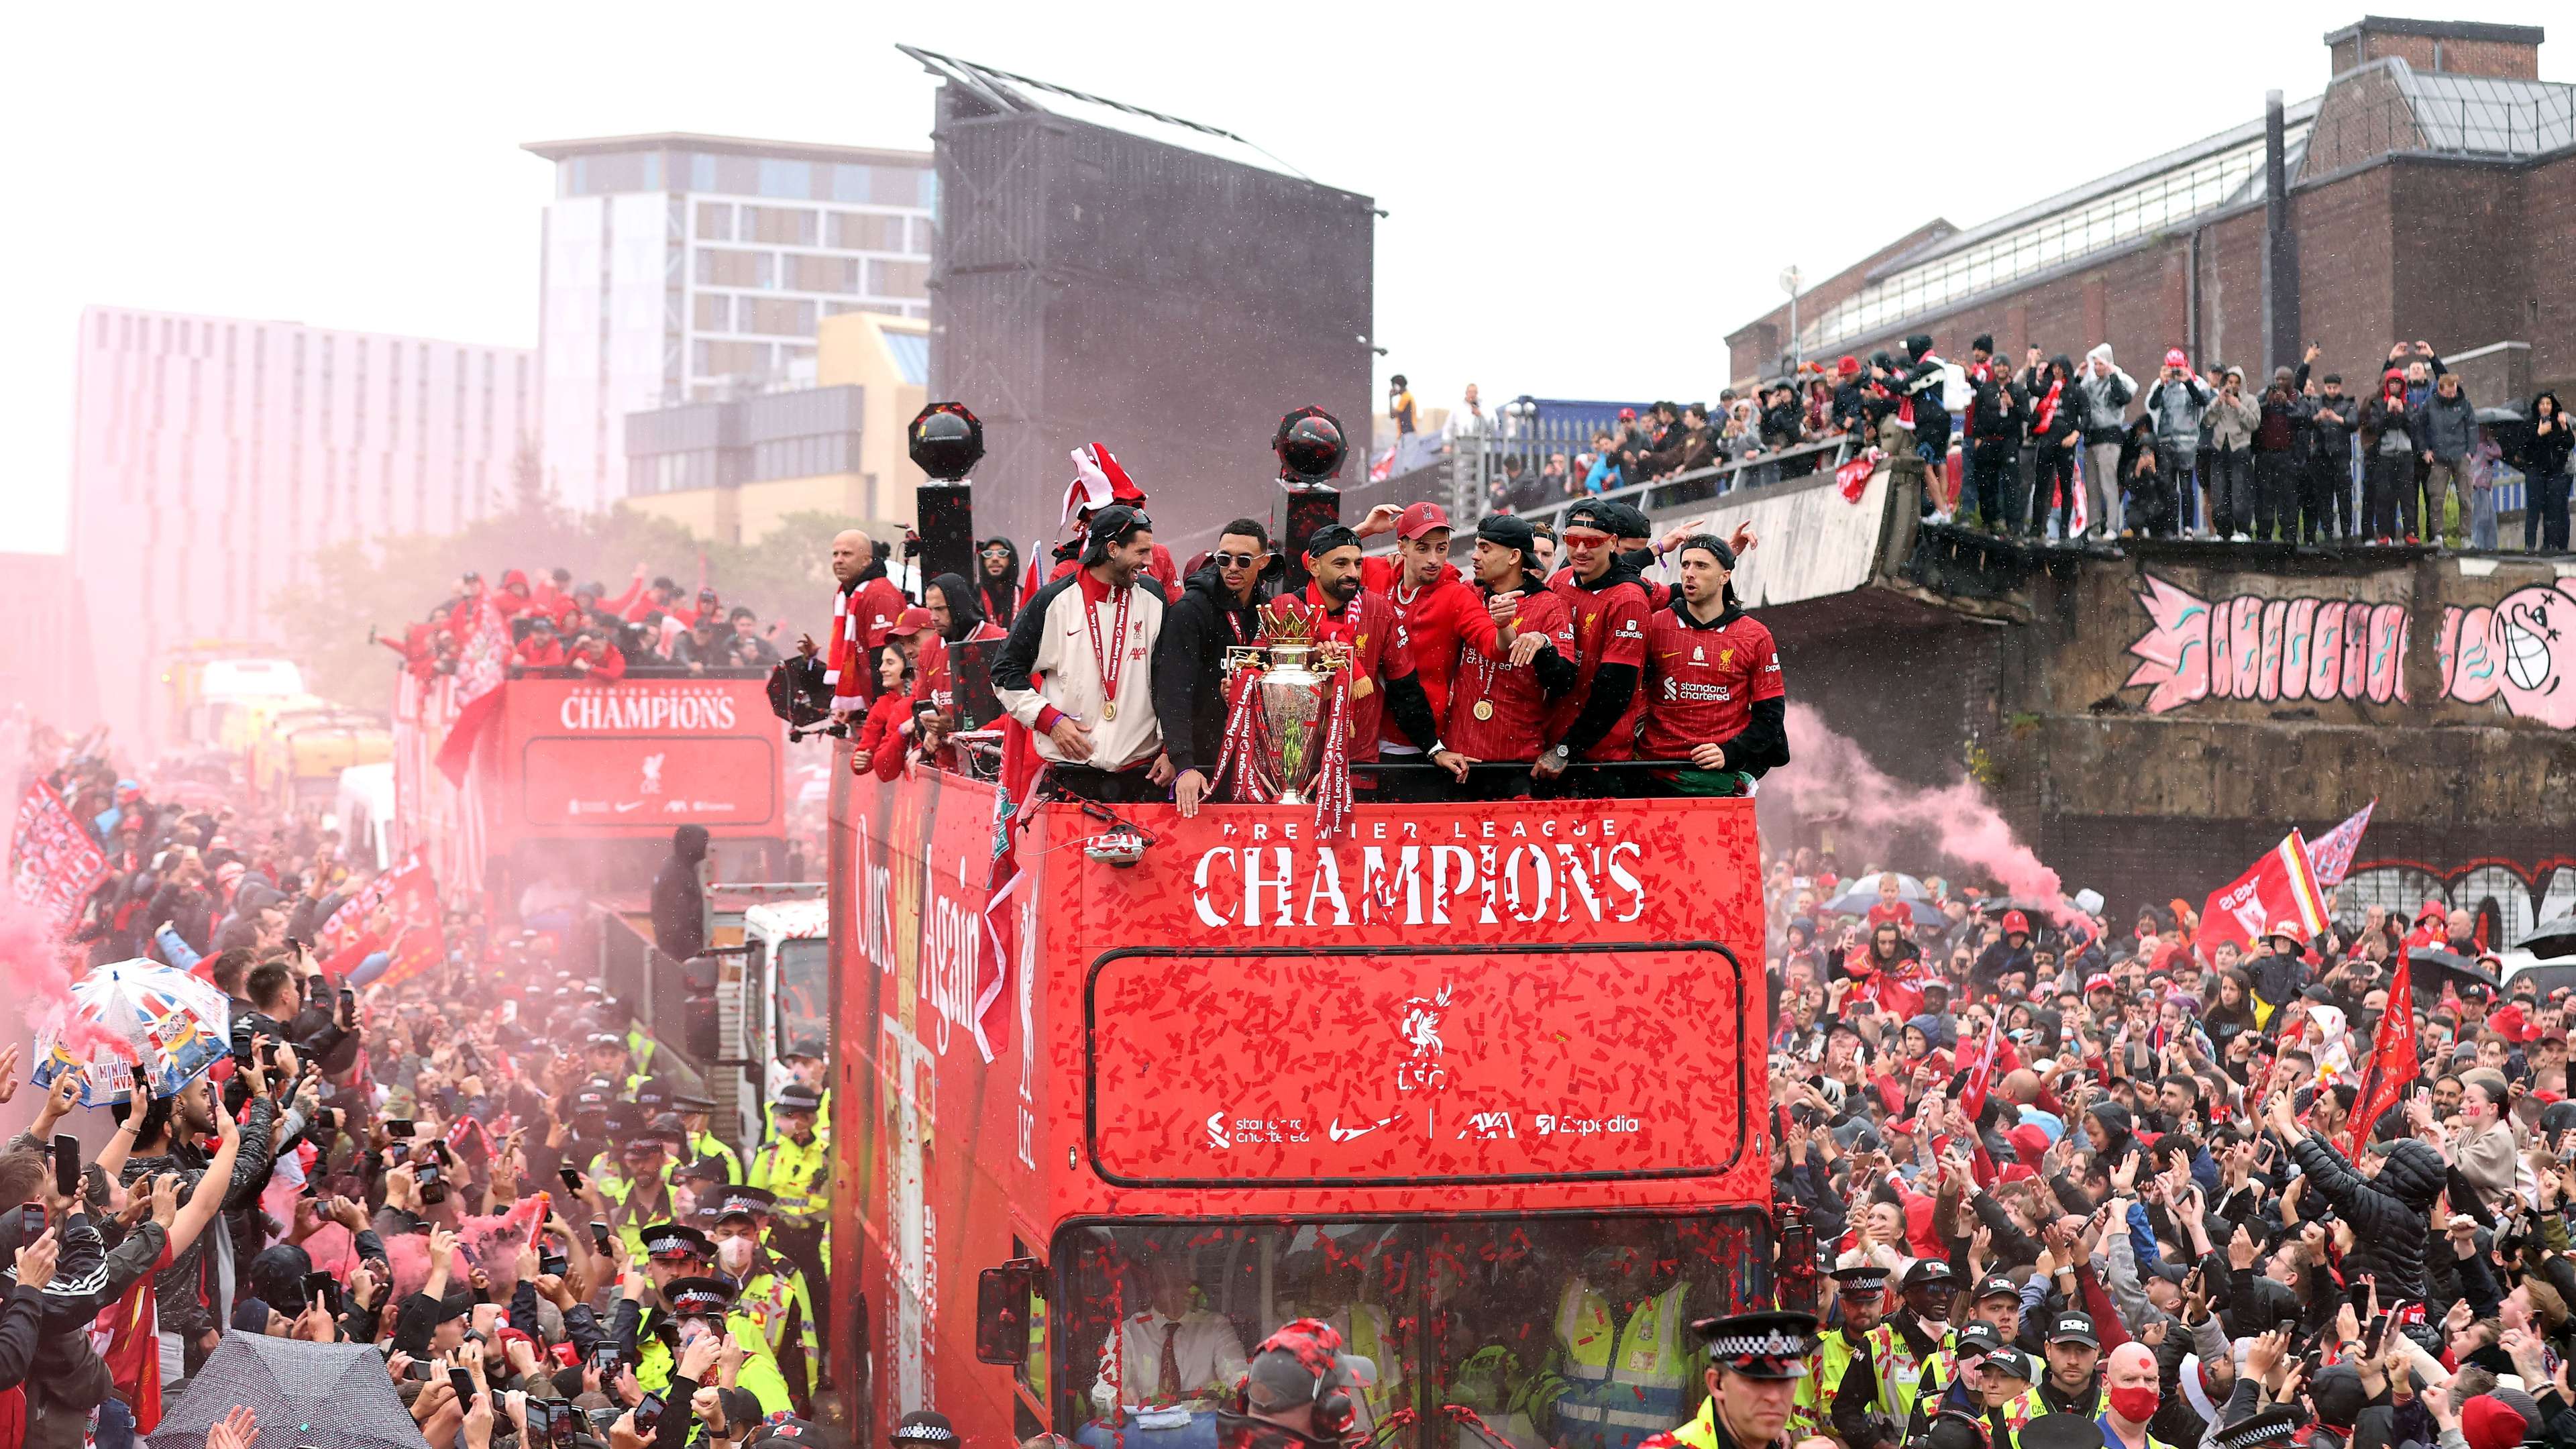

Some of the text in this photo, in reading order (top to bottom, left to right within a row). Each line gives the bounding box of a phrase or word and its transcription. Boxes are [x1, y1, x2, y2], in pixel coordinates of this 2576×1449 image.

[1615, 630, 1644, 639] Expedia
[1110, 637, 1122, 682] Premier League
[1126, 647, 1146, 661] AXA
[1680, 682, 1727, 693] standard
[1680, 691, 1731, 702] chartered
[559, 696, 737, 730] CHAMPIONS
[1226, 674, 1255, 737] Premier League
[1327, 684, 1344, 749] Premier League
[1214, 750, 1229, 781] League
[1237, 752, 1247, 784] League
[1315, 763, 1331, 827] Premier League
[1334, 766, 1344, 799] League
[1343, 780, 1352, 813] Premier
[1454, 819, 1615, 838] LEAGUE
[1193, 841, 1645, 928] CHAMPIONS
[920, 843, 980, 1057] Again
[109, 1070, 158, 1091] INVAN
[1236, 1118, 1303, 1130] standrd
[1560, 1114, 1639, 1136] Expedia
[2469, 1106, 2480, 1116] 20
[1236, 1130, 1309, 1142] charteed
[1456, 1112, 1515, 1140] AXA
